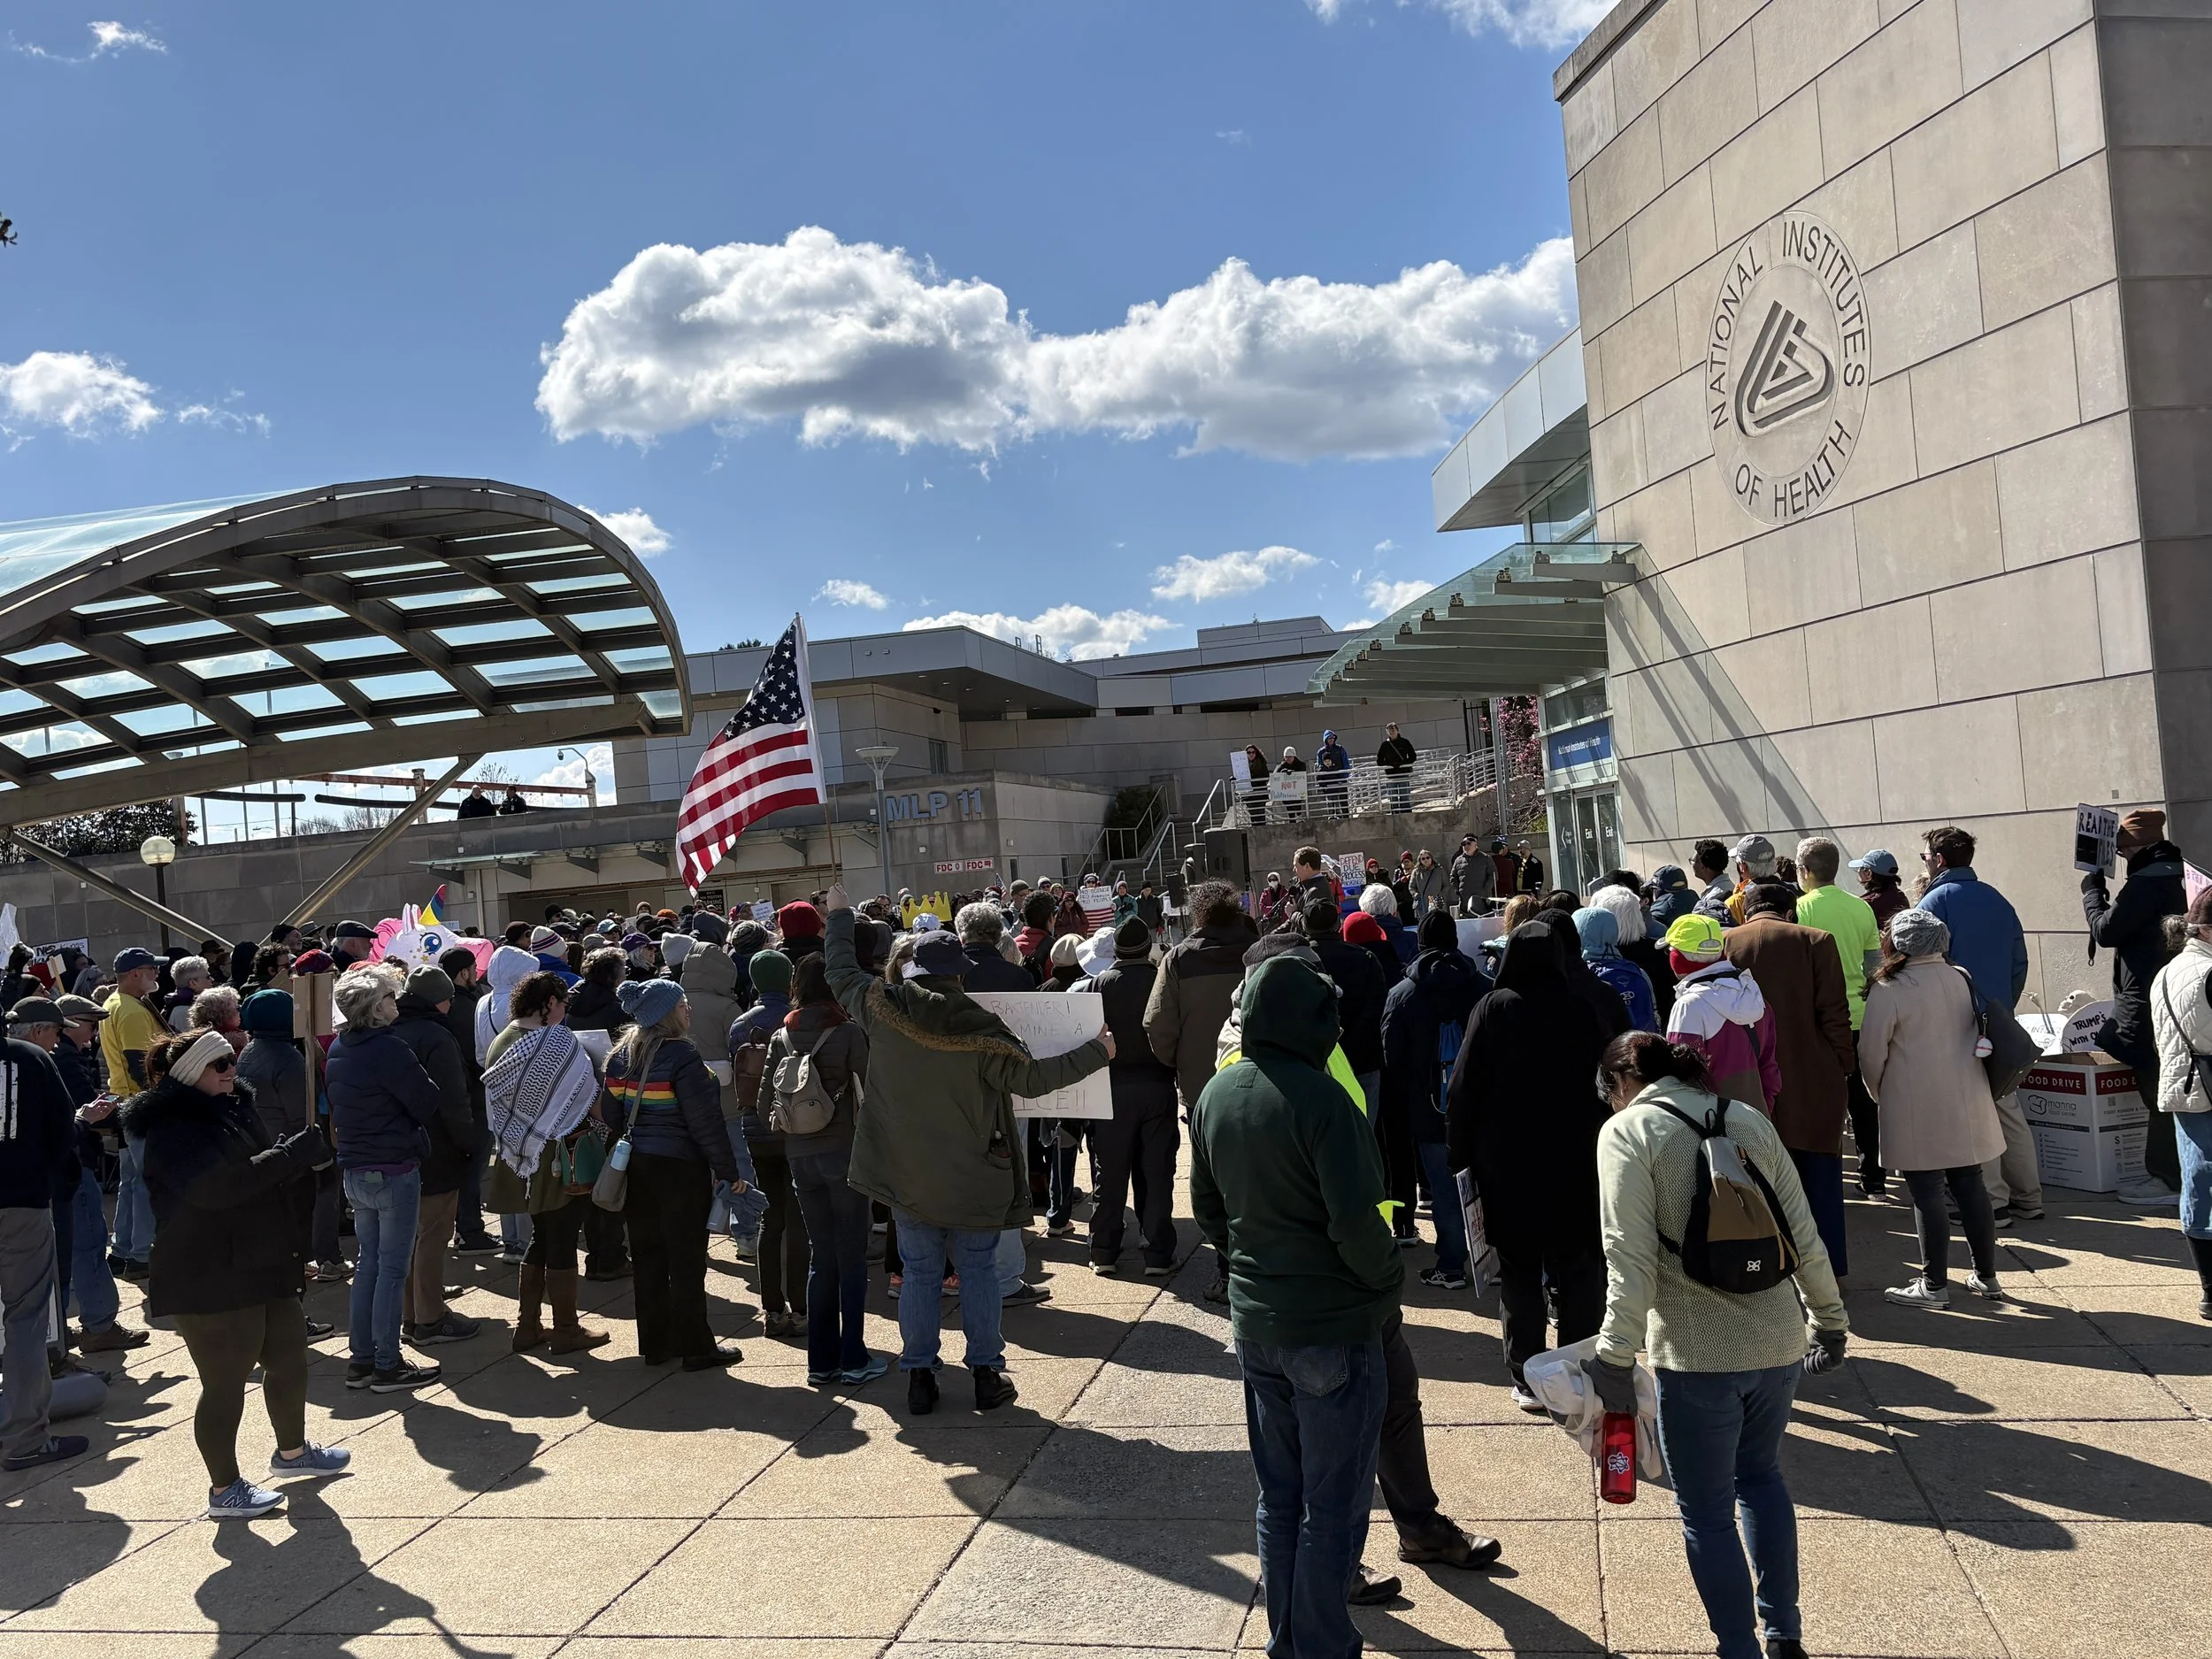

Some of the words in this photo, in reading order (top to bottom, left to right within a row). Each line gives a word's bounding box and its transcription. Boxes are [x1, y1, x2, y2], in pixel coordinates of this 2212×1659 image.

[1709, 246, 1763, 430] NATIONAL
[1782, 220, 1866, 387] INSTITUTES
[1735, 464, 1763, 506] OF
[1774, 419, 1852, 517] HEALTH
[1281, 781, 1297, 790] NOT
[886, 792, 949, 821] MLP
[956, 788, 982, 814] 11
[1585, 828, 1594, 839] Exit
[1605, 826, 1614, 837] Exit
[1340, 855, 1363, 864] DEFEND
[967, 861, 983, 870] FDC
[1340, 871, 1365, 880] PROCESS
[1019, 1024, 1059, 1036] MINE
[1074, 1023, 1083, 1036] A
[2069, 1035, 2089, 1046] WITH
[2052, 1078, 2081, 1089] DRIVE
[2101, 1078, 2128, 1089] FOOD
[2047, 1100, 2077, 1110] manna
